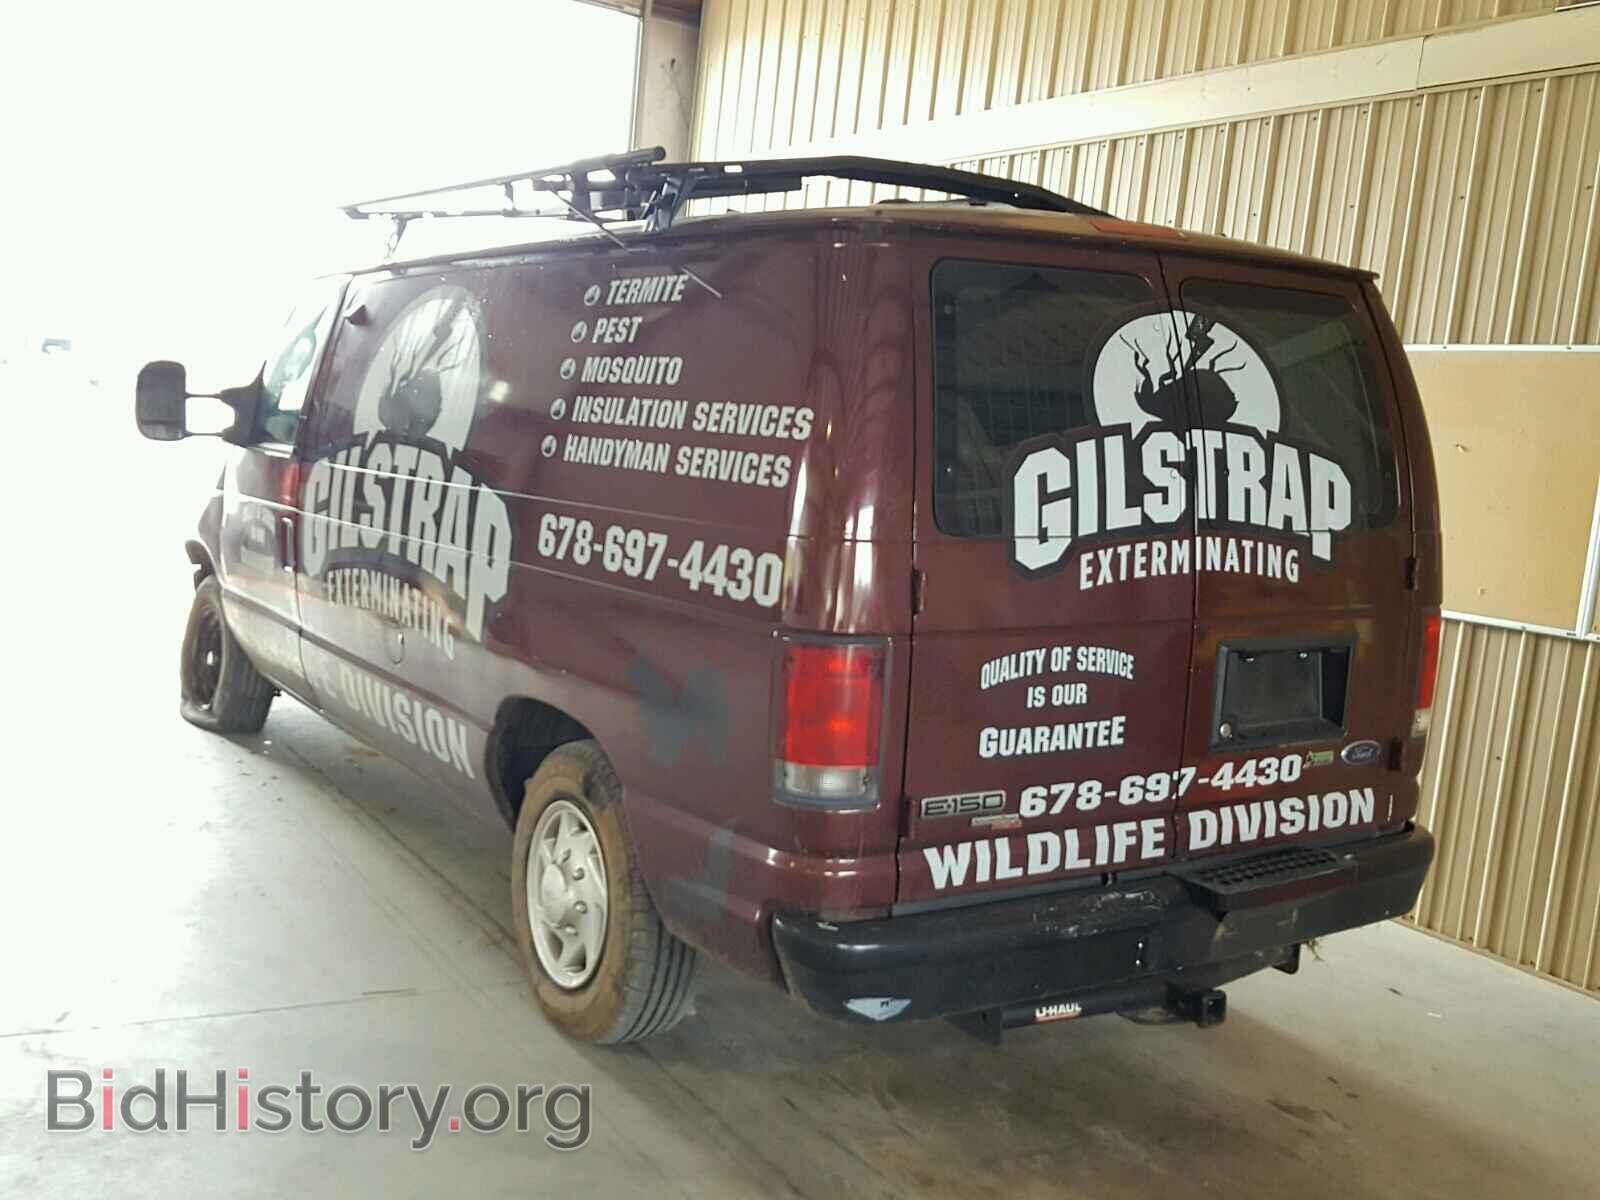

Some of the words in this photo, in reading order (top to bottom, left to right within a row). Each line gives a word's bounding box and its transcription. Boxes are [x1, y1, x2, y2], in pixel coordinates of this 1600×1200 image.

[606, 275, 688, 305] TERMITE
[592, 316, 643, 343] PEST
[581, 356, 683, 385] MOSQUITO
[572, 396, 688, 430] INSULATION
[692, 402, 814, 440] SERVICES
[563, 435, 671, 473] HANDYMAN
[675, 446, 791, 488] SERVICES
[1014, 429, 1351, 570] GILSTRAP
[302, 443, 512, 642] GILSTRAP
[538, 513, 783, 607] 678-697-4430
[1080, 536, 1299, 590] EXTERMINATING
[328, 568, 455, 660] EXTERMINATING
[981, 648, 1047, 690] QUALITY
[1050, 646, 1073, 672] OF
[1076, 646, 1135, 680] SERVICE
[1026, 686, 1046, 708] IS
[1051, 683, 1088, 706] OUR
[341, 671, 475, 779] DIVISION
[979, 716, 1126, 758] GUARANTEE
[1019, 754, 1303, 818] 678-697-4430
[923, 817, 1166, 890] WILDLIFE
[1188, 787, 1375, 850] DIVISION
